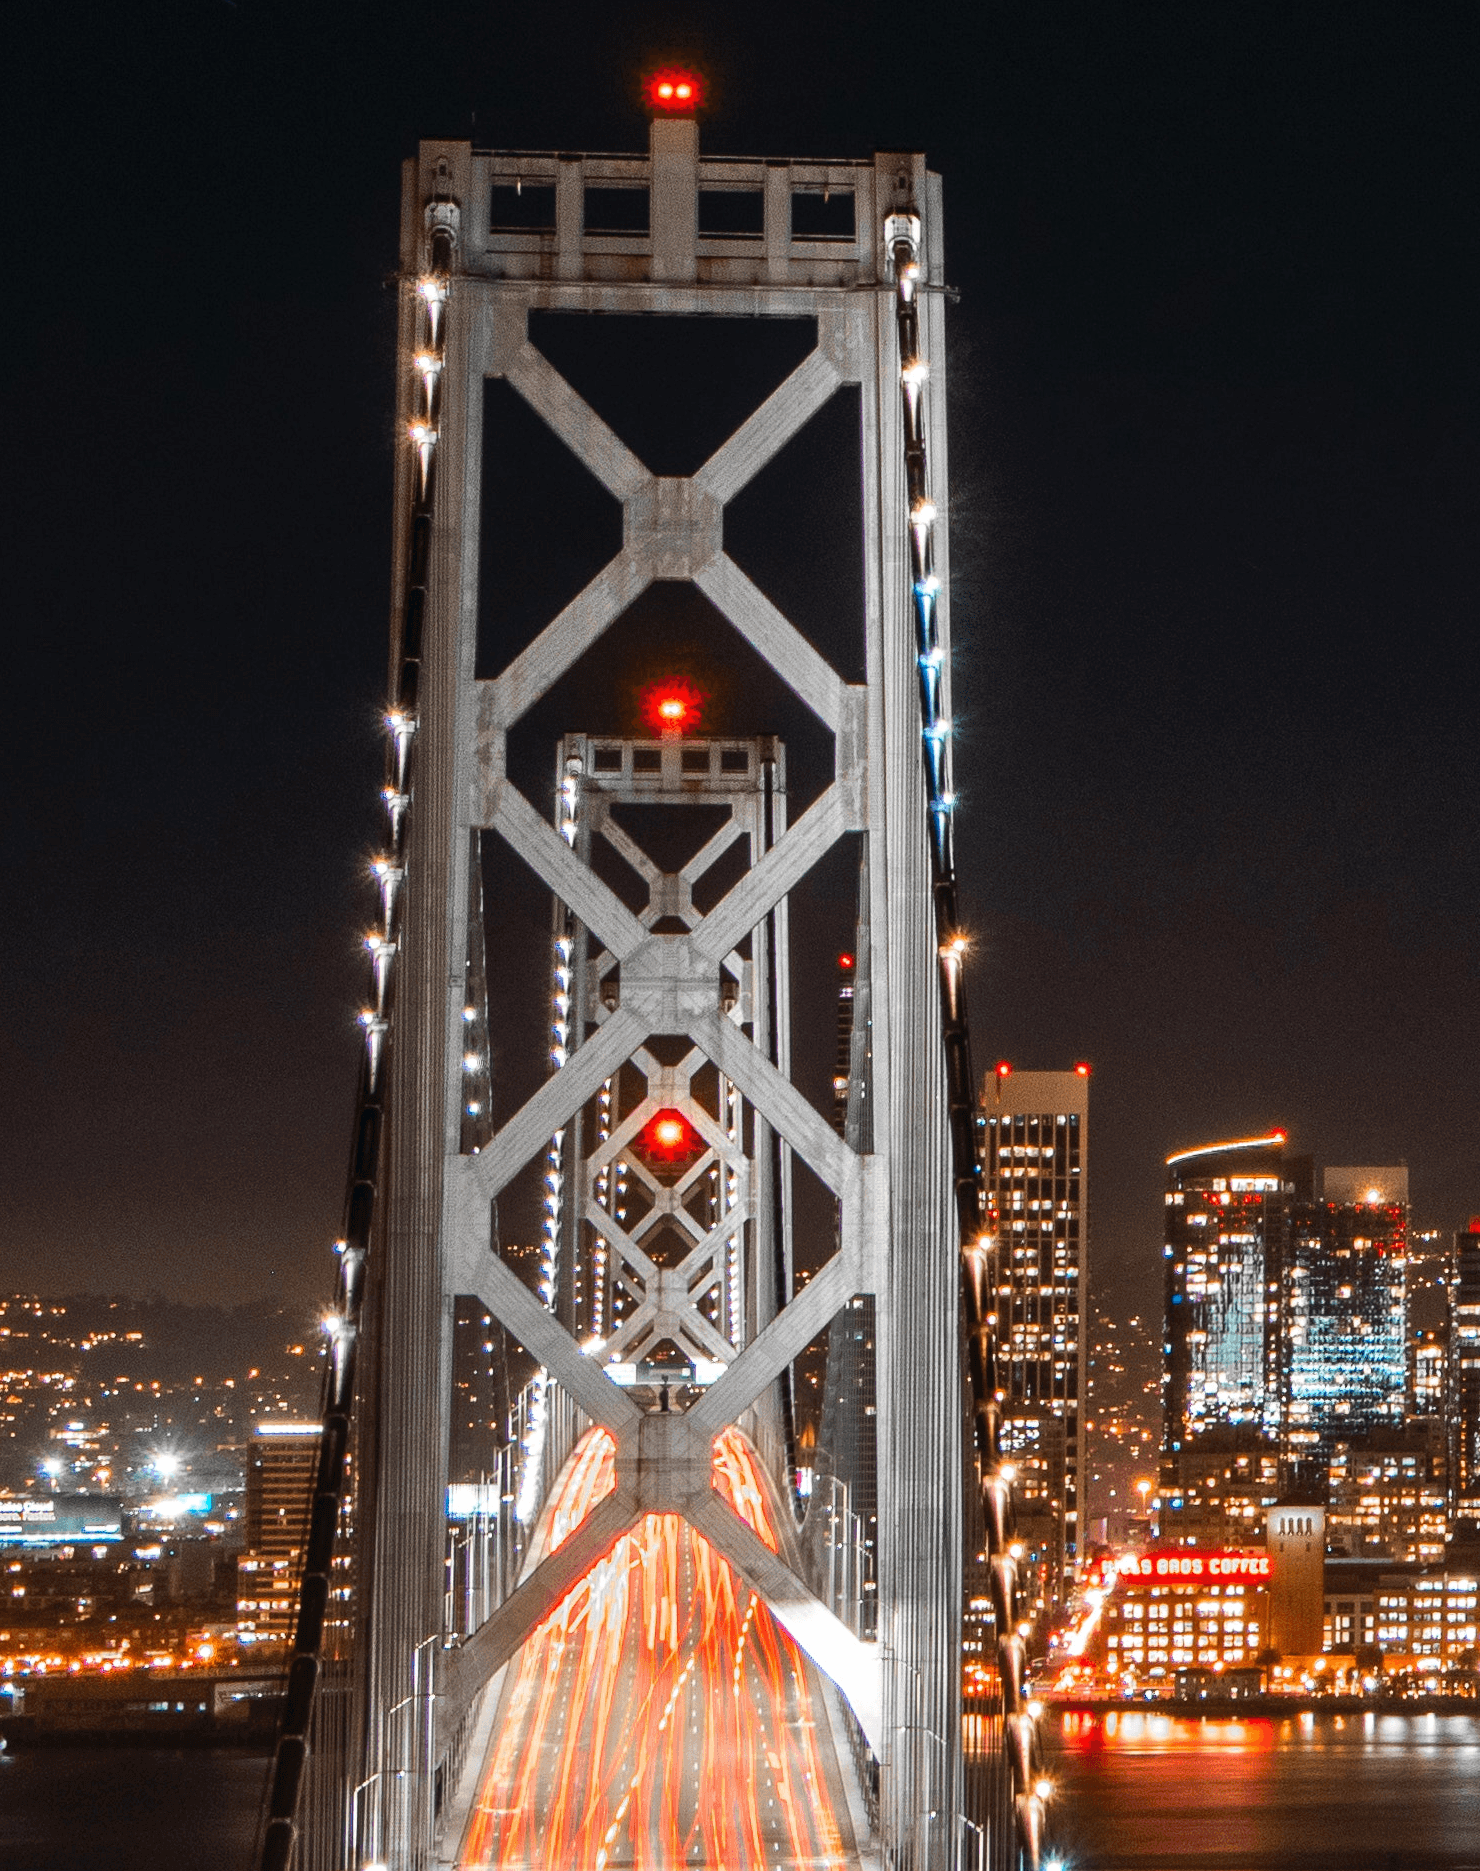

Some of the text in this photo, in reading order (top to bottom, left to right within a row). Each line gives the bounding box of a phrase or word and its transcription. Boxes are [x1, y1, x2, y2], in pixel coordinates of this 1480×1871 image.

[1102, 1558, 1269, 1575] HIS BROS COFFEE
